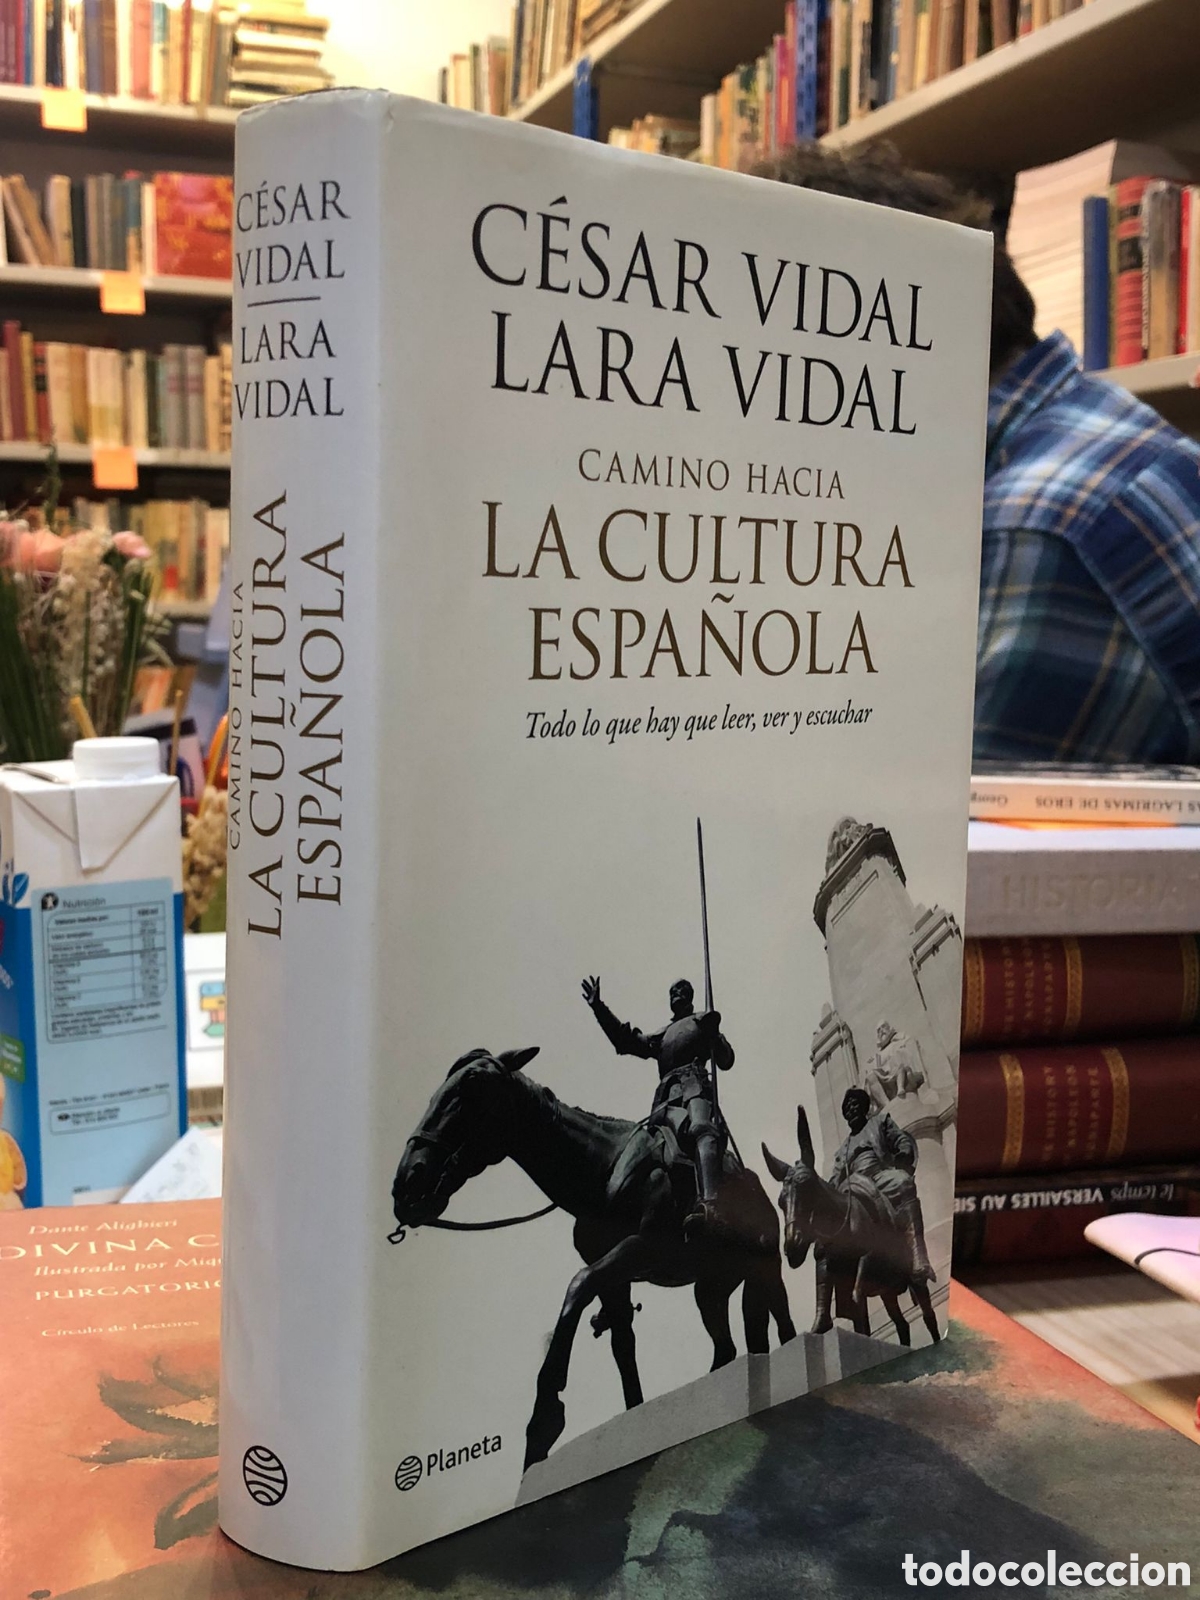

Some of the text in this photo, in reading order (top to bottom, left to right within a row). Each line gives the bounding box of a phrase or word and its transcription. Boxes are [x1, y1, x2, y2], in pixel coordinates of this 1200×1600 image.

[237, 181, 349, 232] CÉSAR
[236, 240, 345, 288] VIDAL
[472, 196, 933, 352] CÉSAR VIDAL
[242, 320, 335, 364] LARA
[491, 310, 917, 435] LARA VIDAL
[235, 378, 344, 419] VIDAL
[579, 449, 844, 499] CAMINO HACIA
[482, 501, 915, 587] LA CULTURA
[528, 593, 878, 680] ESPAÑOLA
[229, 581, 244, 850] CAMINO HACIA
[248, 490, 286, 940] LA CULTURA
[290, 533, 344, 906] ESPAÑOLA
[526, 699, 872, 745] Todo lo que hay que leer, ver y escuchar
[1035, 795, 1073, 809] EROS
[1081, 797, 1098, 810] DE
[981, 1194, 1006, 1211] AU
[1011, 1187, 1103, 1210] VERSAILLES
[1111, 1181, 1156, 1200] temps
[1160, 1184, 1174, 1201] le
[28, 1219, 178, 1235] Dante Alighieri
[0, 1237, 172, 1260] DIVINA
[34, 1262, 126, 1276] Ilustrada
[134, 1261, 168, 1272] por
[41, 1326, 103, 1337] Círculo
[133, 1319, 200, 1330] Lectores
[427, 1436, 501, 1476] Planeta
